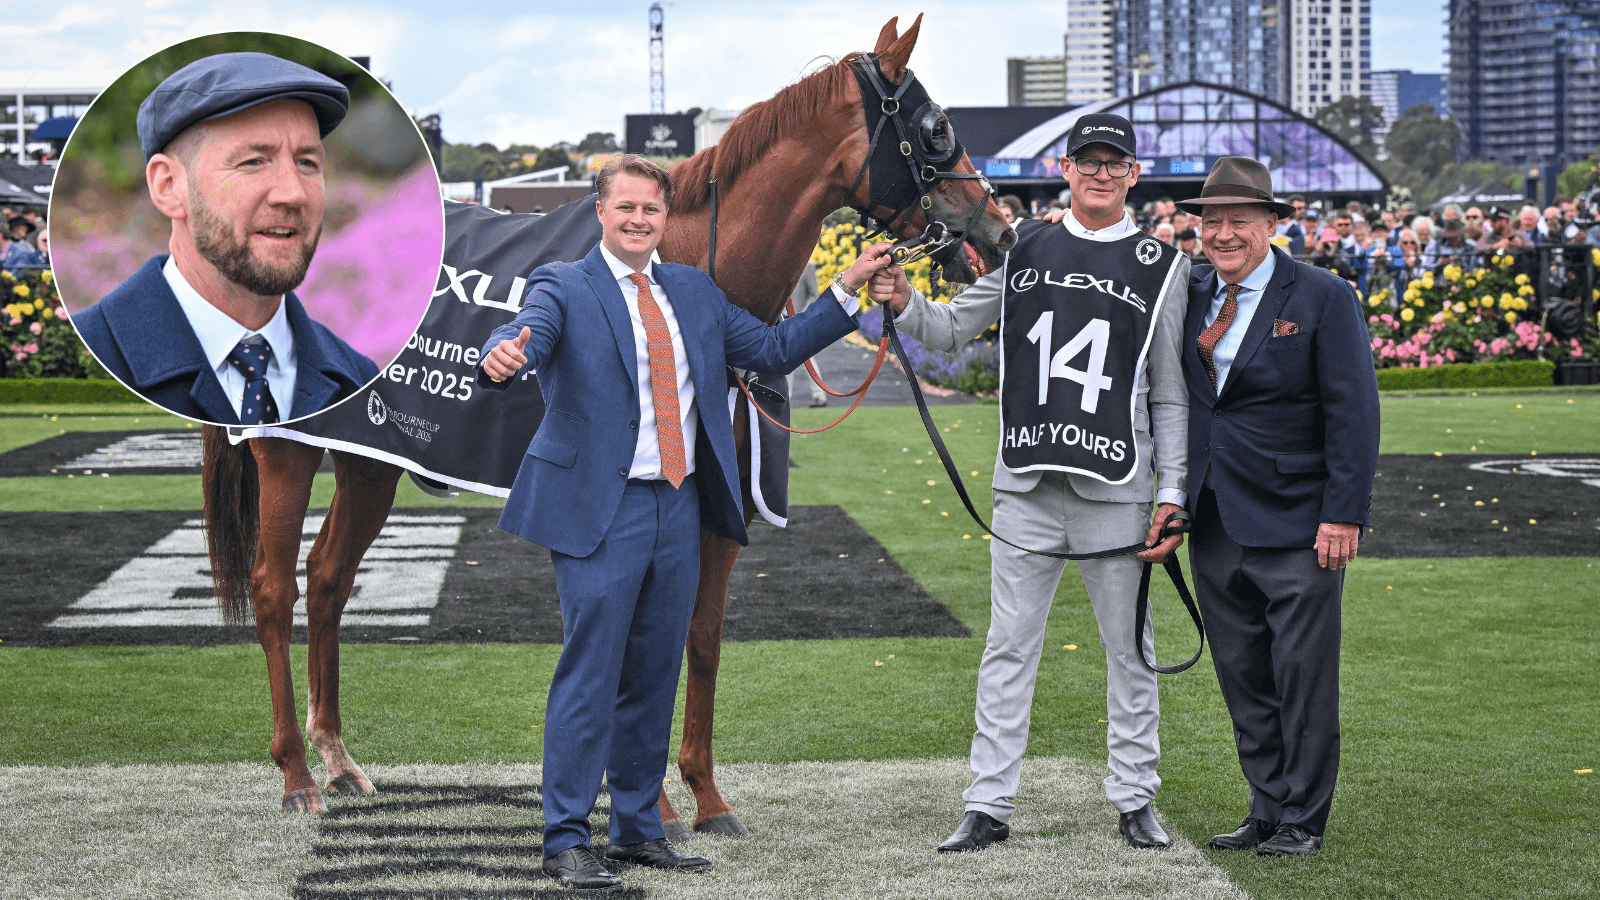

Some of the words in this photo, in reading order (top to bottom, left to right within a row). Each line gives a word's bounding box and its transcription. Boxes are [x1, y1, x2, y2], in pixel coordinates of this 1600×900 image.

[1044, 270, 1147, 314] LEXUS
[420, 365, 475, 401] 2025
[1026, 310, 1113, 415] 14
[1005, 423, 1046, 449] HALF
[1049, 422, 1127, 462] YOURS
